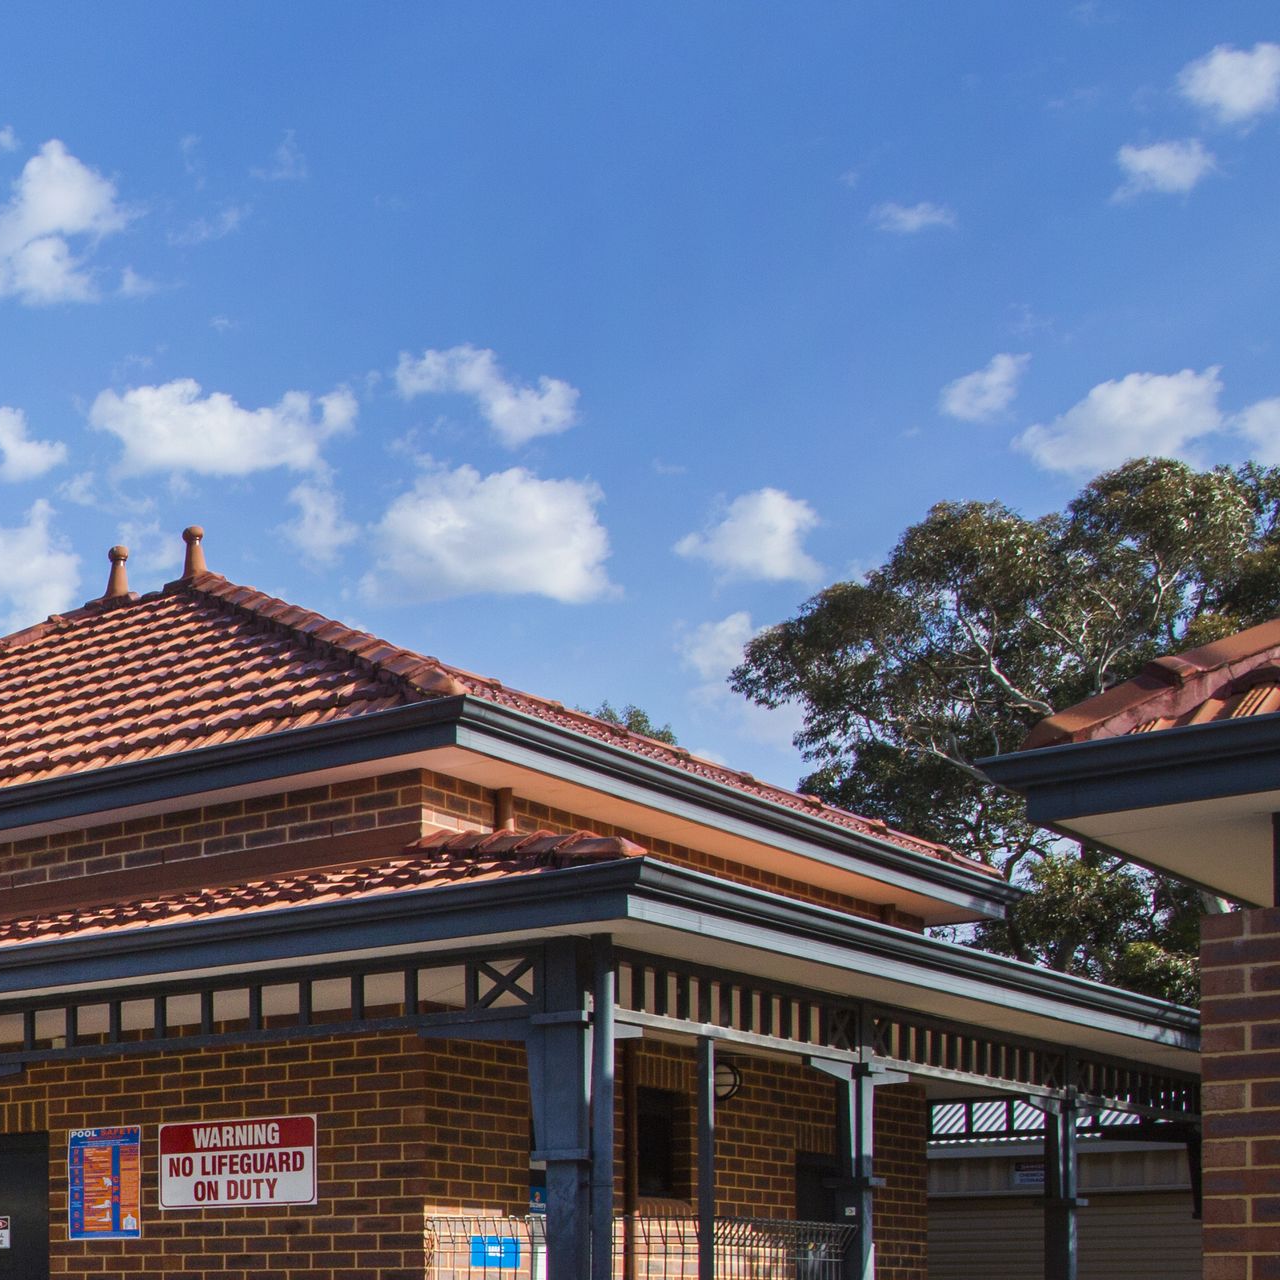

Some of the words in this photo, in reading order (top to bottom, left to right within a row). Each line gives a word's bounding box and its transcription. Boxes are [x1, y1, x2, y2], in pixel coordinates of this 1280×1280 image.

[71, 1130, 97, 1138] POOL
[101, 1127, 138, 1137] SAFETY
[192, 1122, 280, 1149] WARNING
[169, 1156, 194, 1178] NO
[201, 1150, 305, 1177] LIFEGUARD
[194, 1180, 219, 1202] ON
[227, 1178, 278, 1200] DUTY
